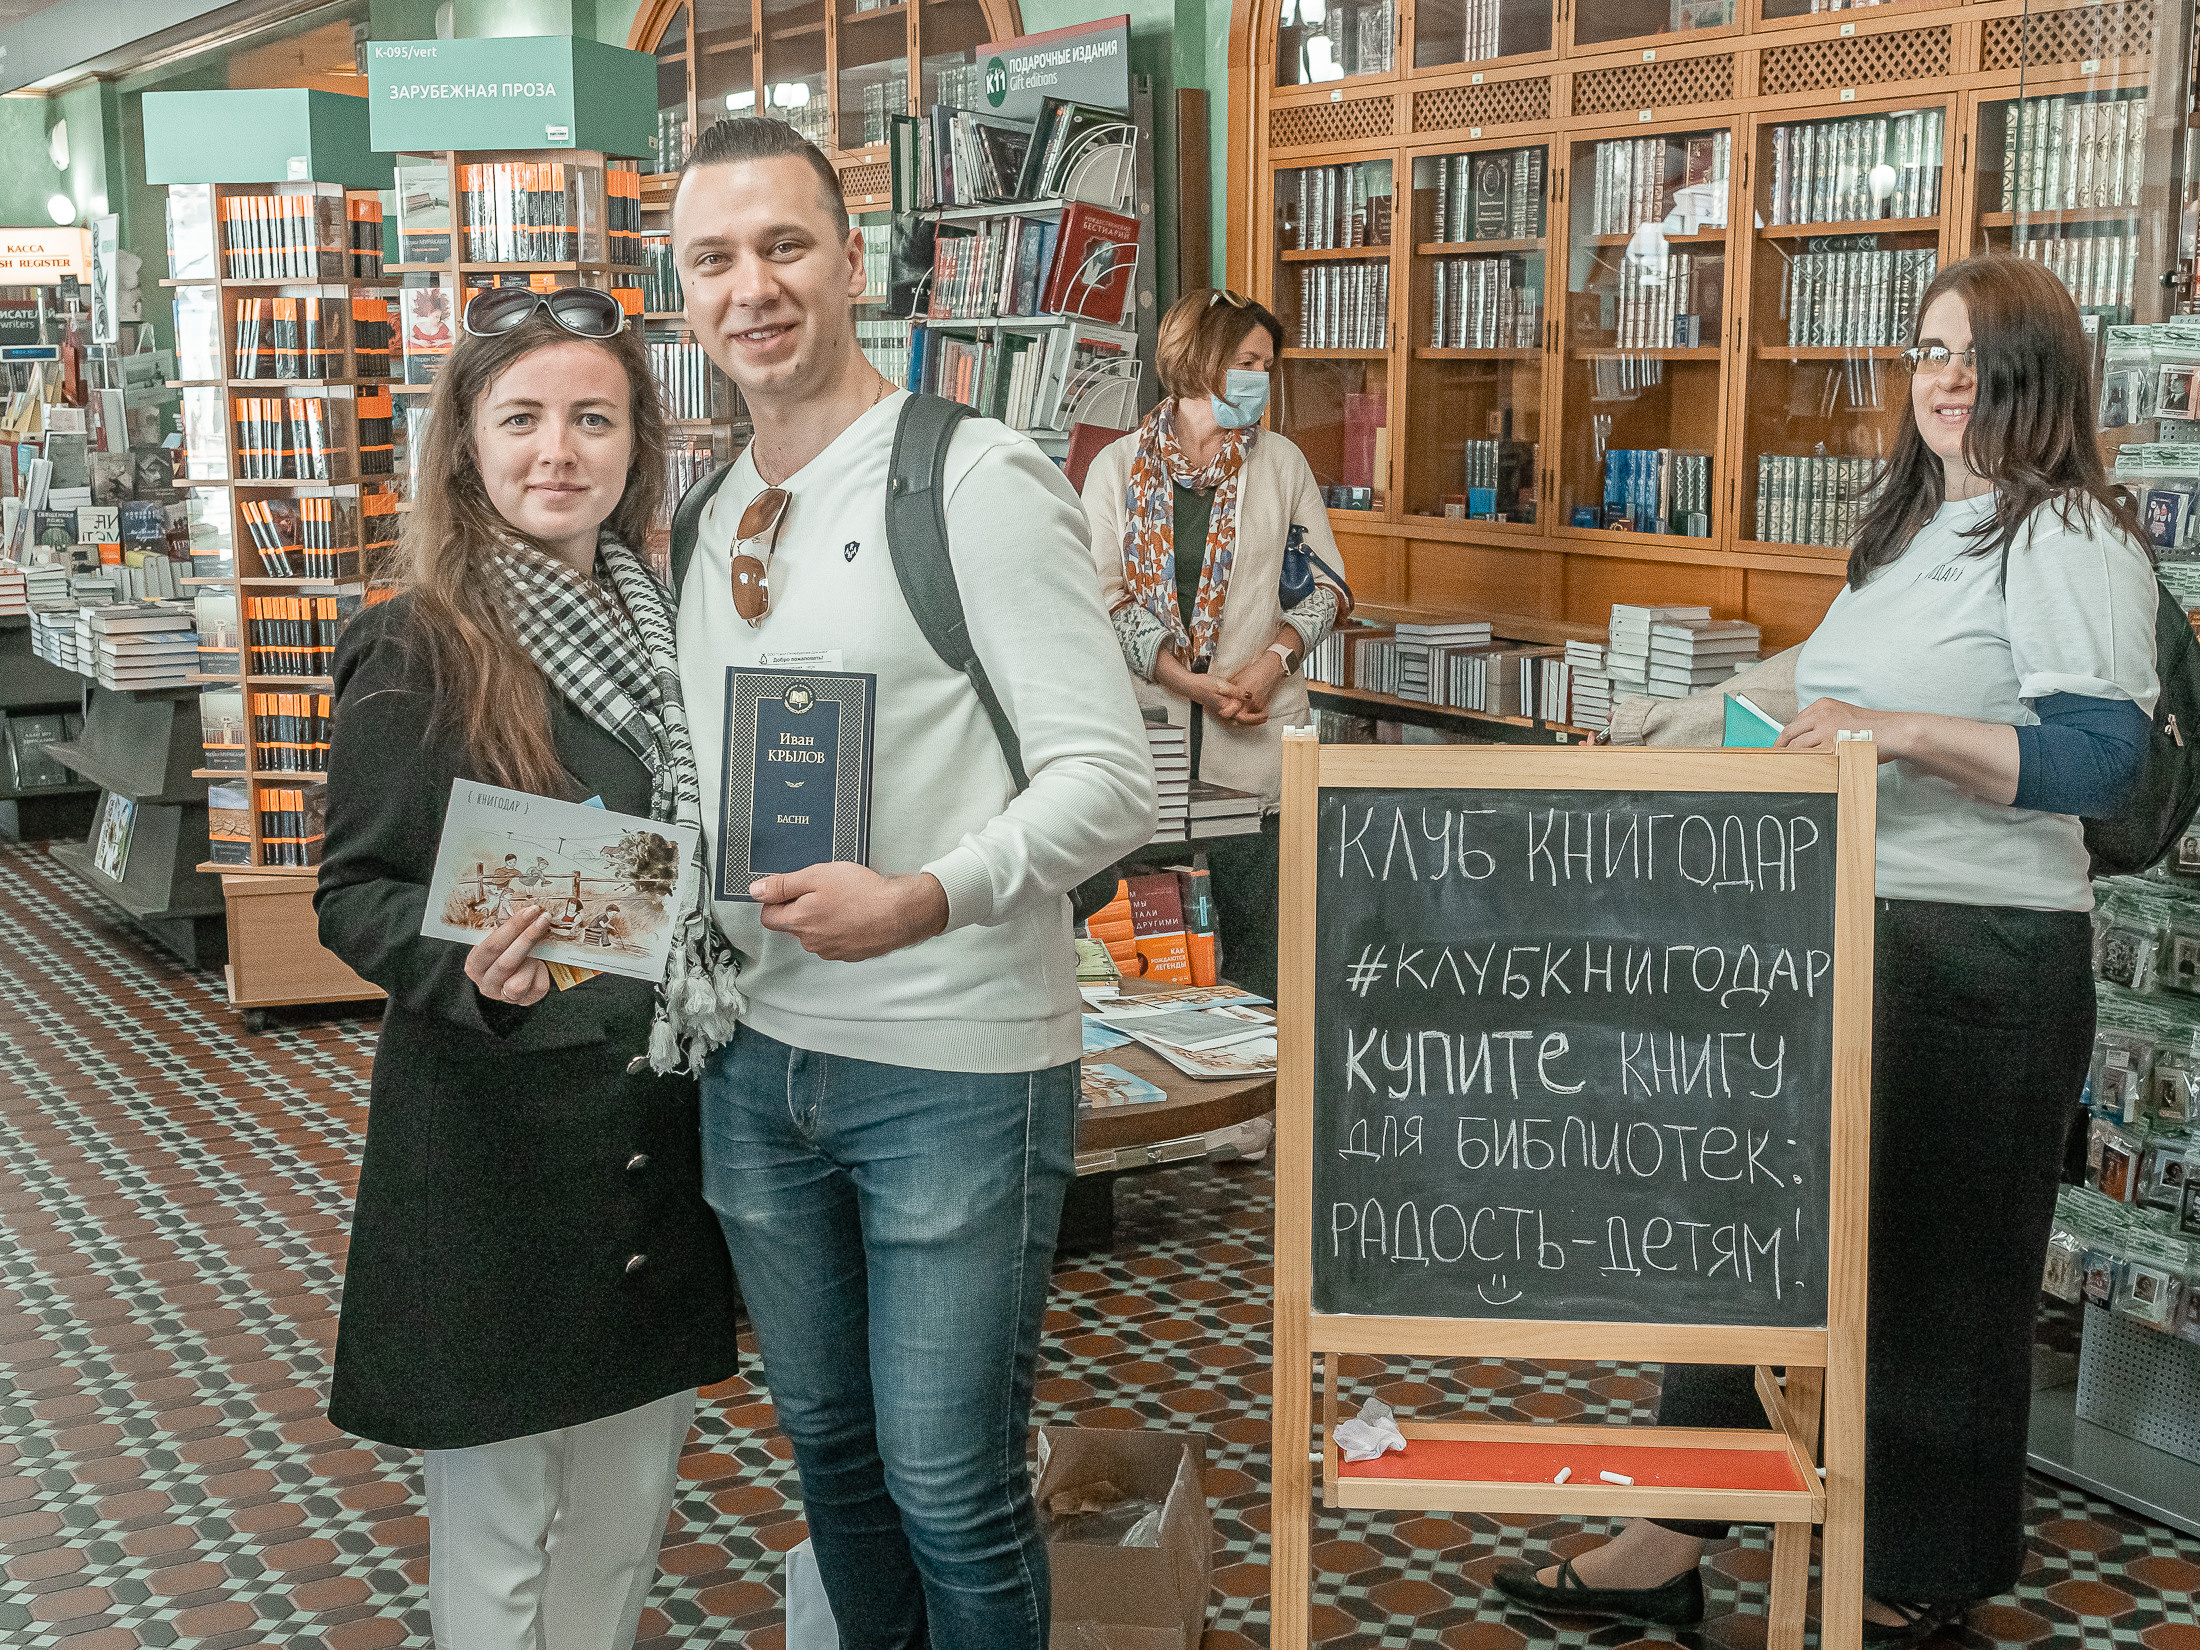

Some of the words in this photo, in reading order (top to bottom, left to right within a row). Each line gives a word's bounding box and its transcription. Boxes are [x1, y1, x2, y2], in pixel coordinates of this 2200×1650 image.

[1009, 48, 1072, 75] ПОДАРОЧНЫЕ
[1072, 39, 1118, 63] ИЗДАНИЯ
[986, 70, 1006, 95] K11
[1009, 75, 1025, 92] Gift
[1025, 71, 1058, 90] editions
[389, 83, 497, 100] ЗАРУБЕЖНАЯ
[501, 82, 557, 98] ПРОЗА
[7, 244, 45, 253] КАССА
[19, 258, 71, 267] REGISTER
[780, 732, 815, 746] Иван
[768, 749, 826, 764] КРЫЛОВ
[777, 814, 810, 825] БАСНИ
[1339, 805, 1497, 881] КЛУБ
[1526, 807, 1820, 894] КНИГОДАР
[1136, 918, 1179, 930] ДРУГИМИ
[1170, 947, 1185, 955] КАК
[1154, 961, 1187, 972] ЛЕГЕНДЫ
[1347, 942, 1831, 1008] #КЛУБКНИГОДАР
[1620, 1030, 1786, 1099] КНИГУ
[1338, 1115, 1423, 1162] ДЛЯ
